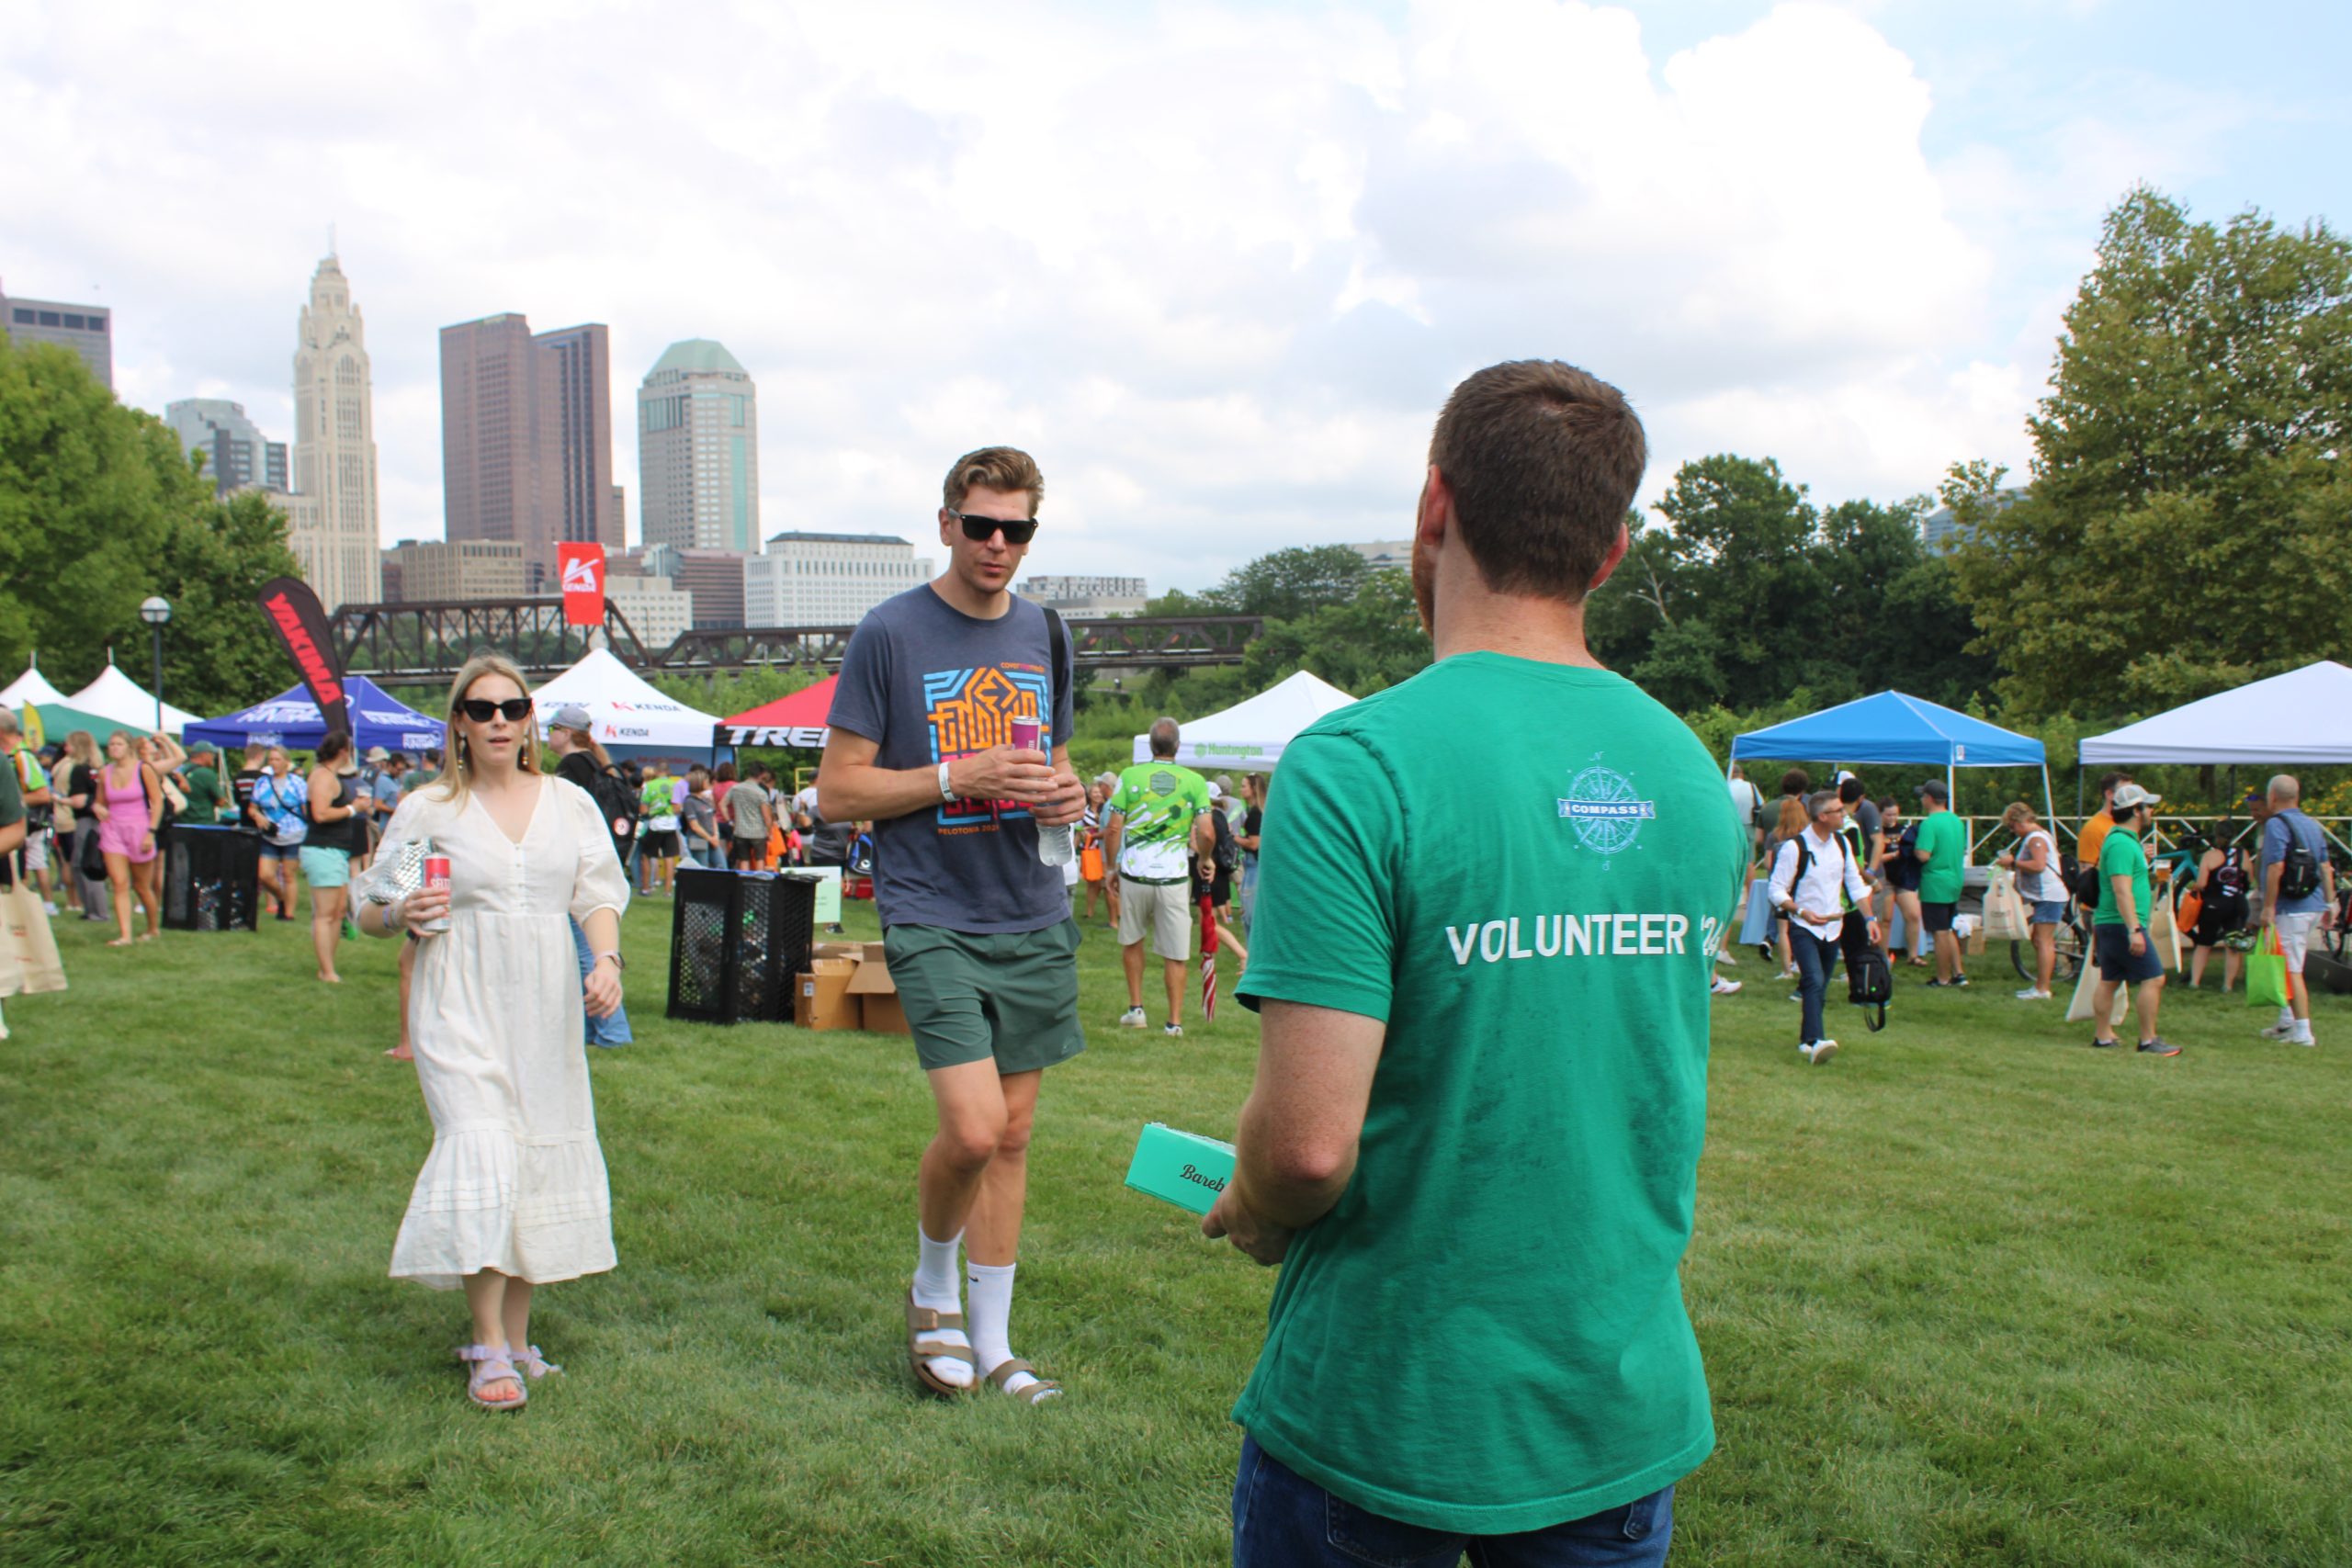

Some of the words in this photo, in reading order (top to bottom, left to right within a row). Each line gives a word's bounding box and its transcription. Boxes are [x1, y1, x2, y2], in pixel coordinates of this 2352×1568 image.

[265, 591, 342, 705] YAKIMA
[635, 704, 682, 713] KENDA
[619, 728, 650, 737] KENDA
[1208, 742, 1263, 760] Huntington
[1571, 803, 1638, 816] COMPASS
[1445, 914, 1690, 965] VOLUNTEER
[1180, 1164, 1226, 1192] Bareb
